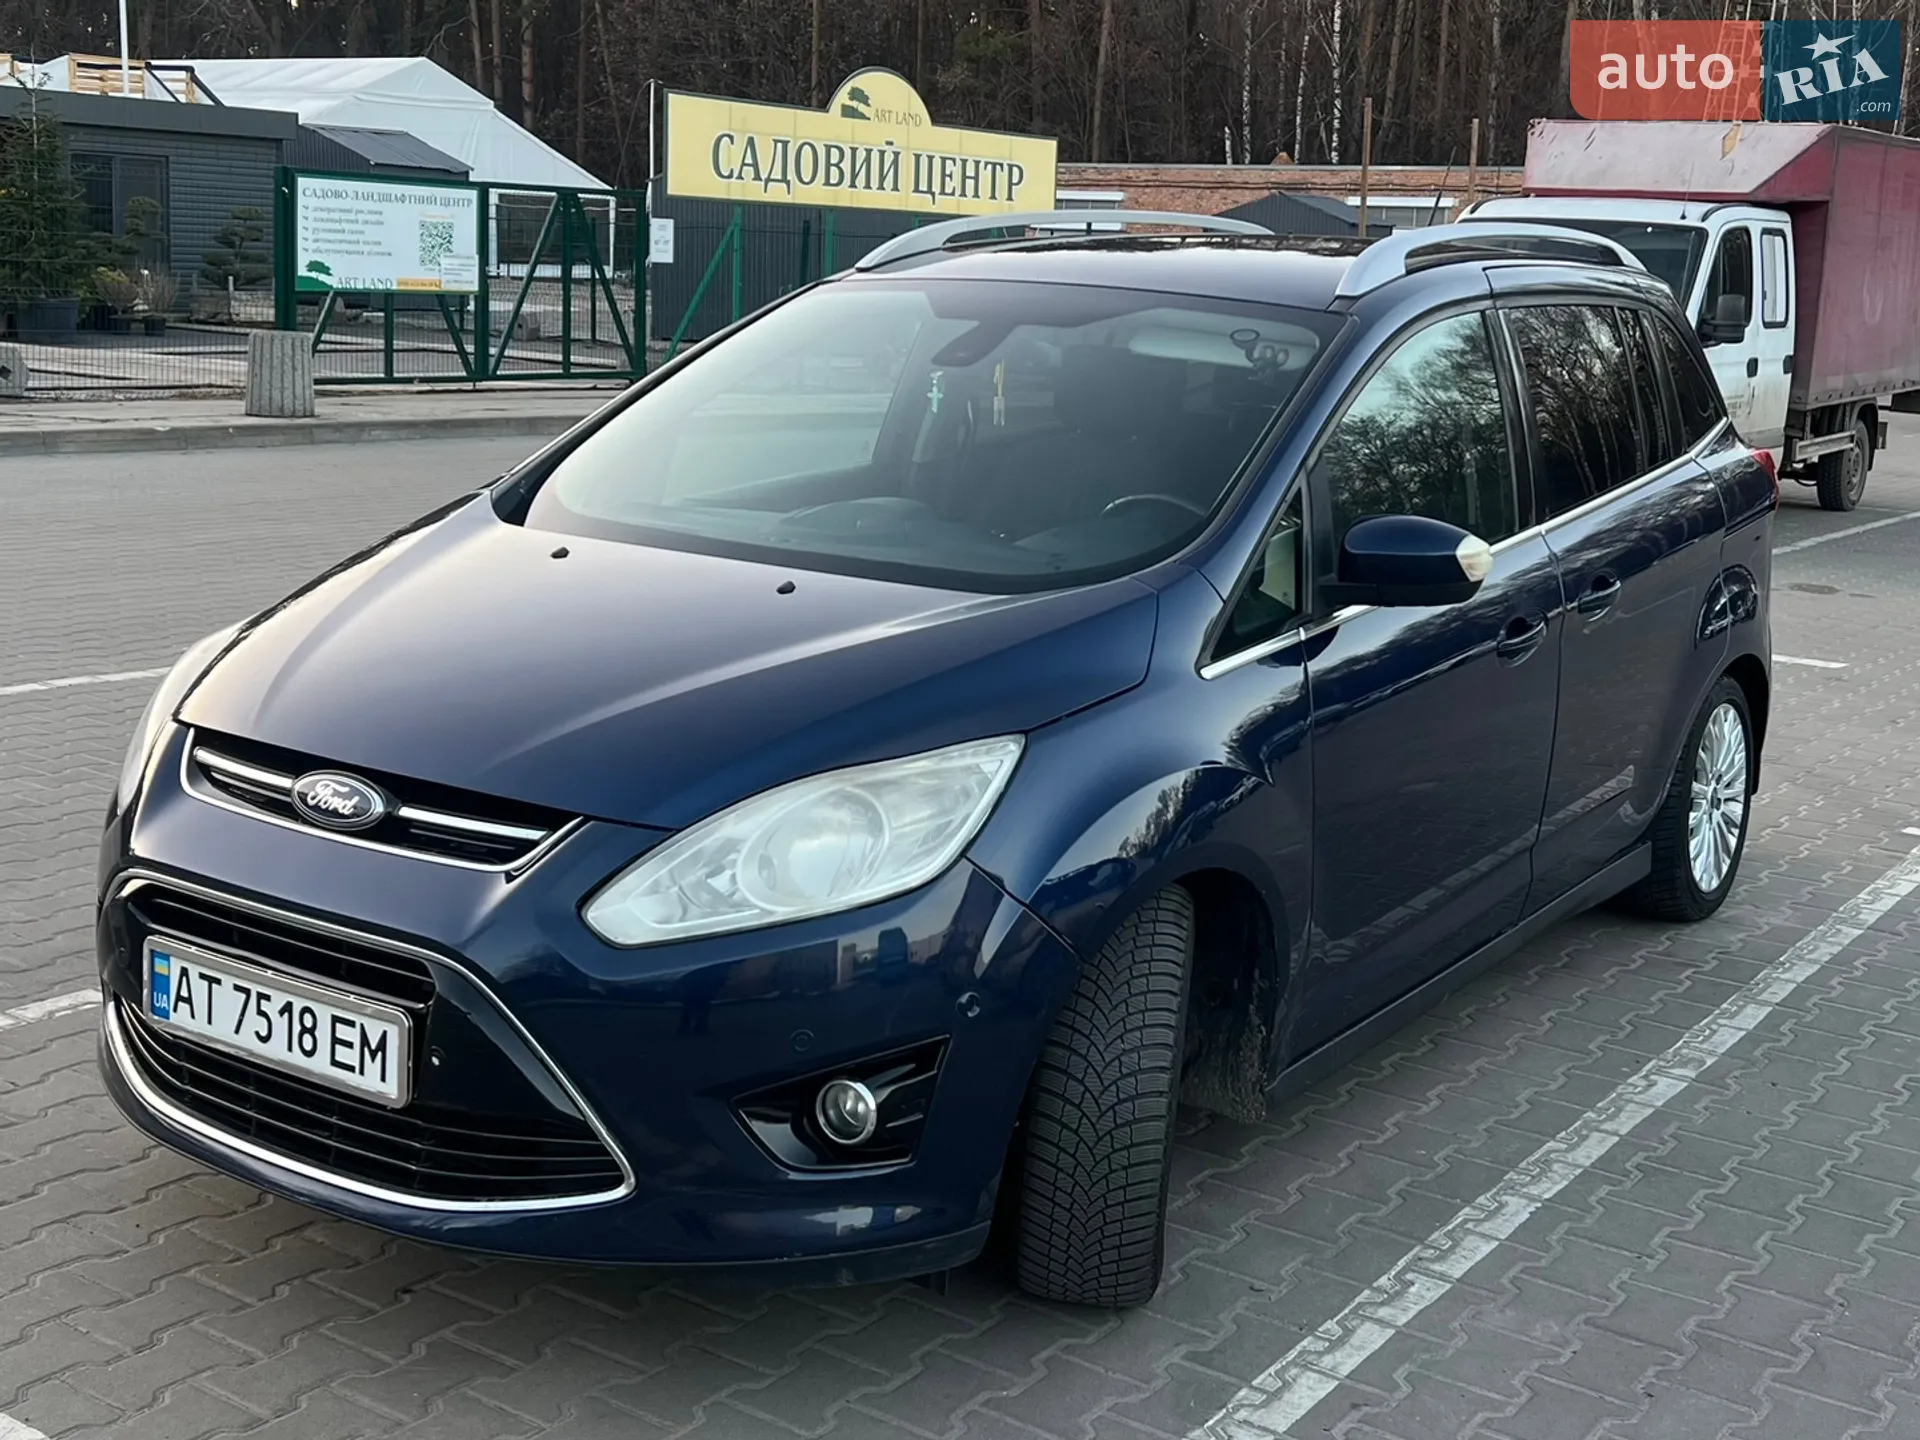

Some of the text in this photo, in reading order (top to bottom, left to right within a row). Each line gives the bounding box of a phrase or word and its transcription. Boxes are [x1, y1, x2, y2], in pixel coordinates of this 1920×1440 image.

[873, 107, 922, 127] ART LAND
[711, 132, 1024, 206] САДОВИЙ ЦЕНТР
[439, 195, 474, 209] ЦЕНТР
[337, 277, 359, 289] ART
[363, 278, 393, 290] LAND
[307, 780, 358, 816] Ford
[153, 992, 168, 1011] UA
[172, 966, 388, 1084] AT 7518 EM
